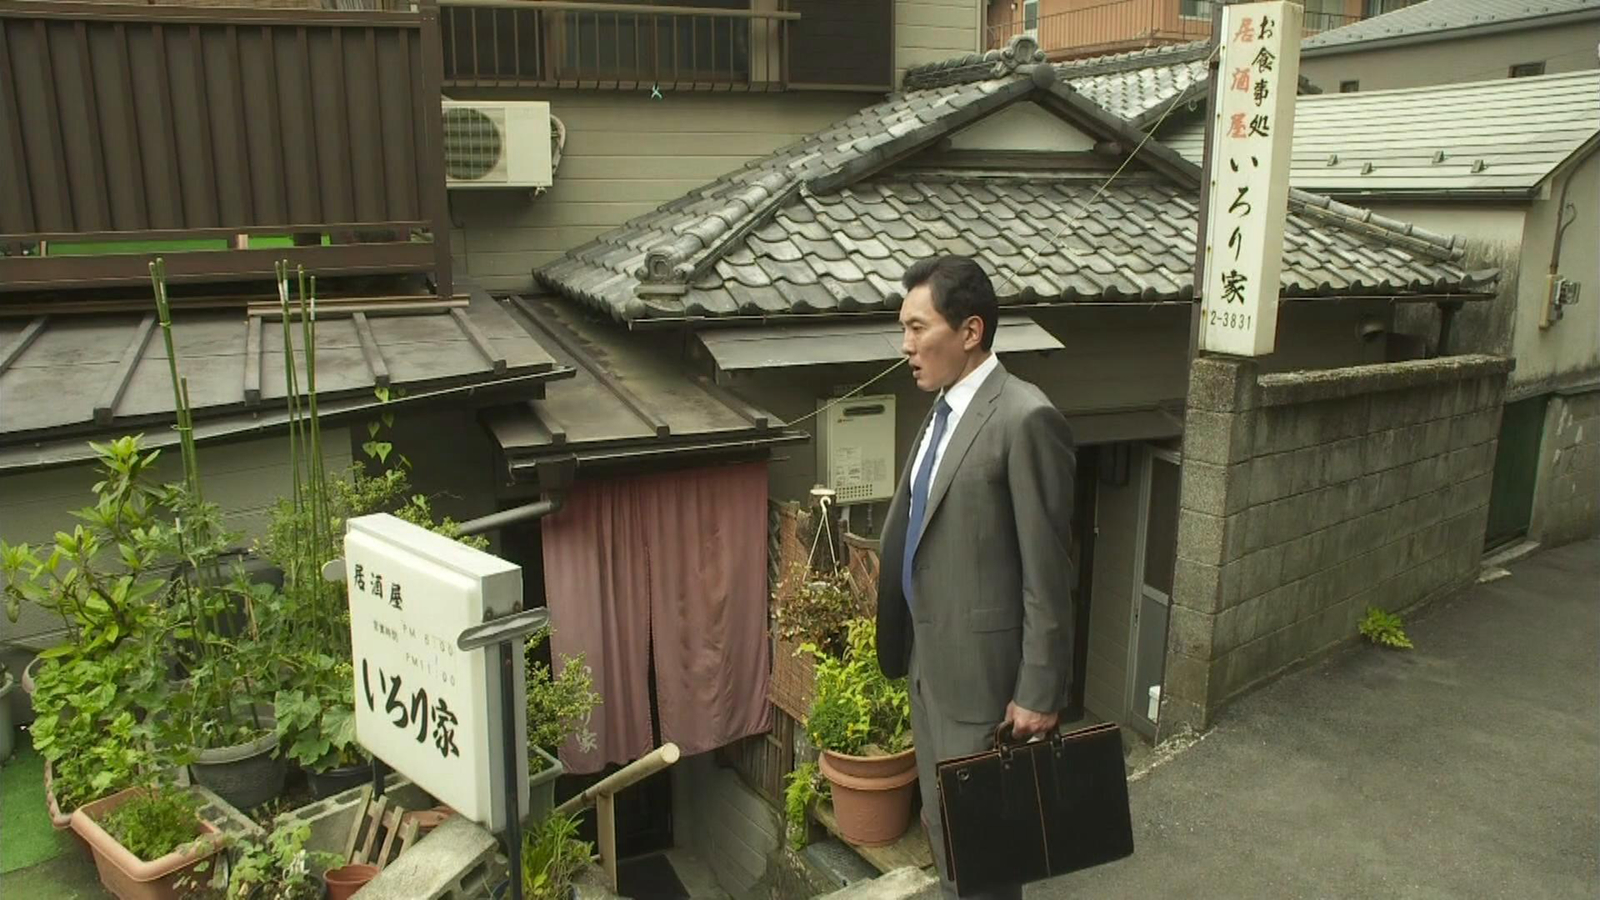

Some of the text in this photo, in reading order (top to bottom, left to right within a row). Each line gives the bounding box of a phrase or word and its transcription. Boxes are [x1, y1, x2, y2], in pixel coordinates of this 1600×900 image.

[1227, 18, 1254, 138] 居酒屋
[1248, 15, 1276, 137] お食事処
[1221, 156, 1259, 304] いろり家
[1210, 310, 1251, 330] 2-3831
[353, 563, 403, 611] 居酒屋
[362, 657, 460, 758] いろり家
